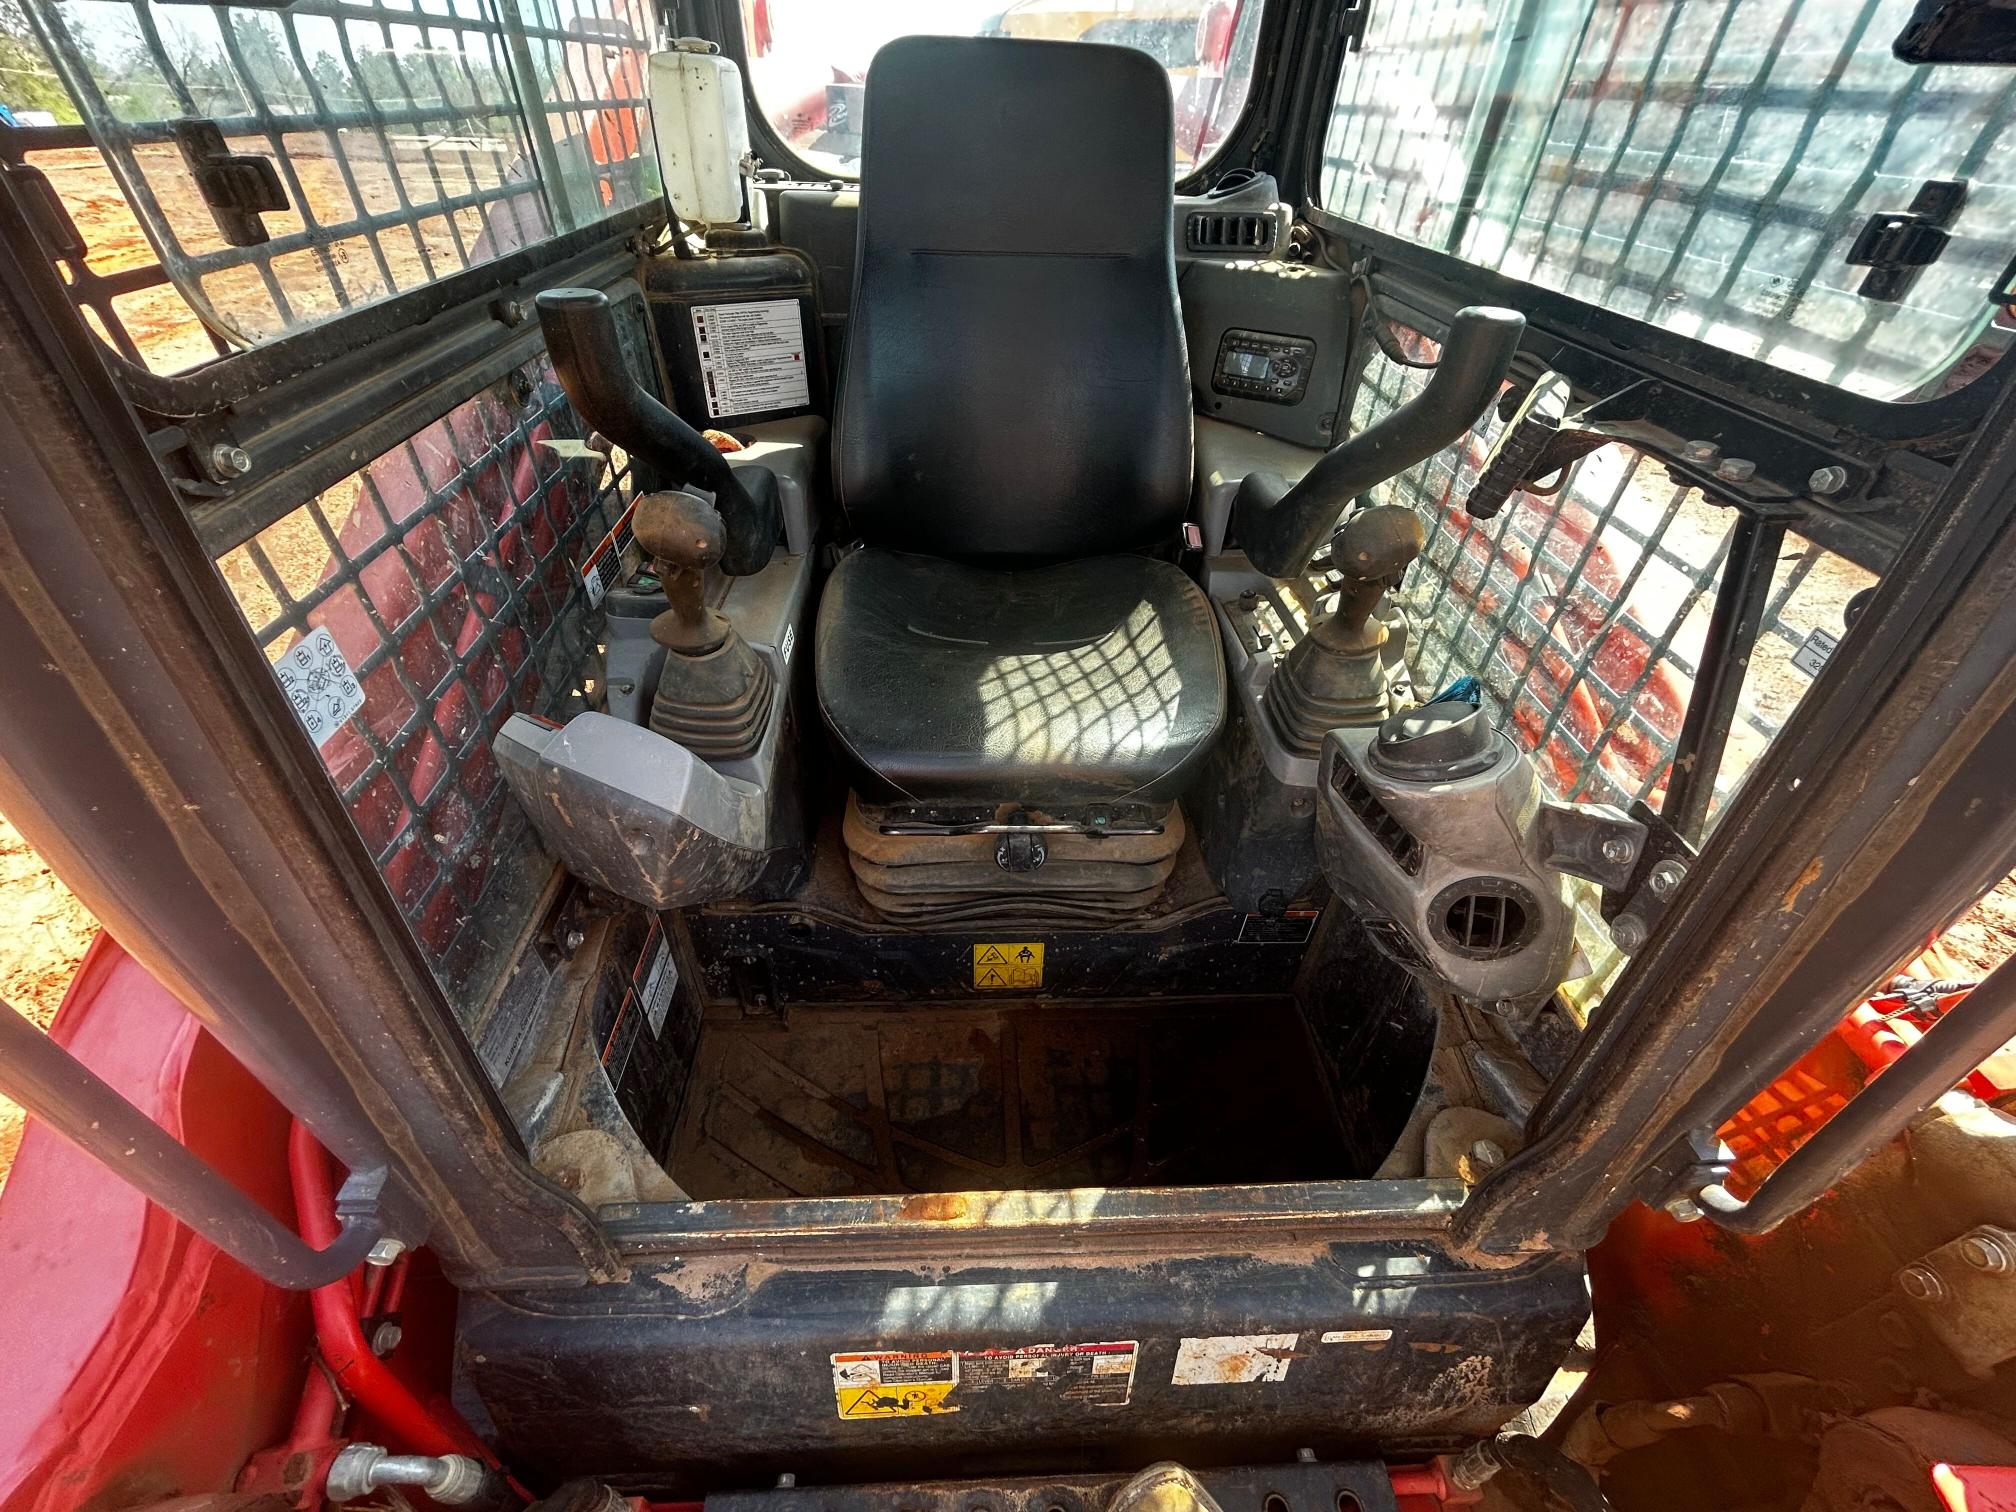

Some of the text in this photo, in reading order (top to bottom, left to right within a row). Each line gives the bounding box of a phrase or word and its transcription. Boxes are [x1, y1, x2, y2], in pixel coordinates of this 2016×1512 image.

[1810, 635, 1833, 654] Rated
[504, 1032, 522, 1067] KUBOTA
[873, 1353, 928, 1361] WARNING
